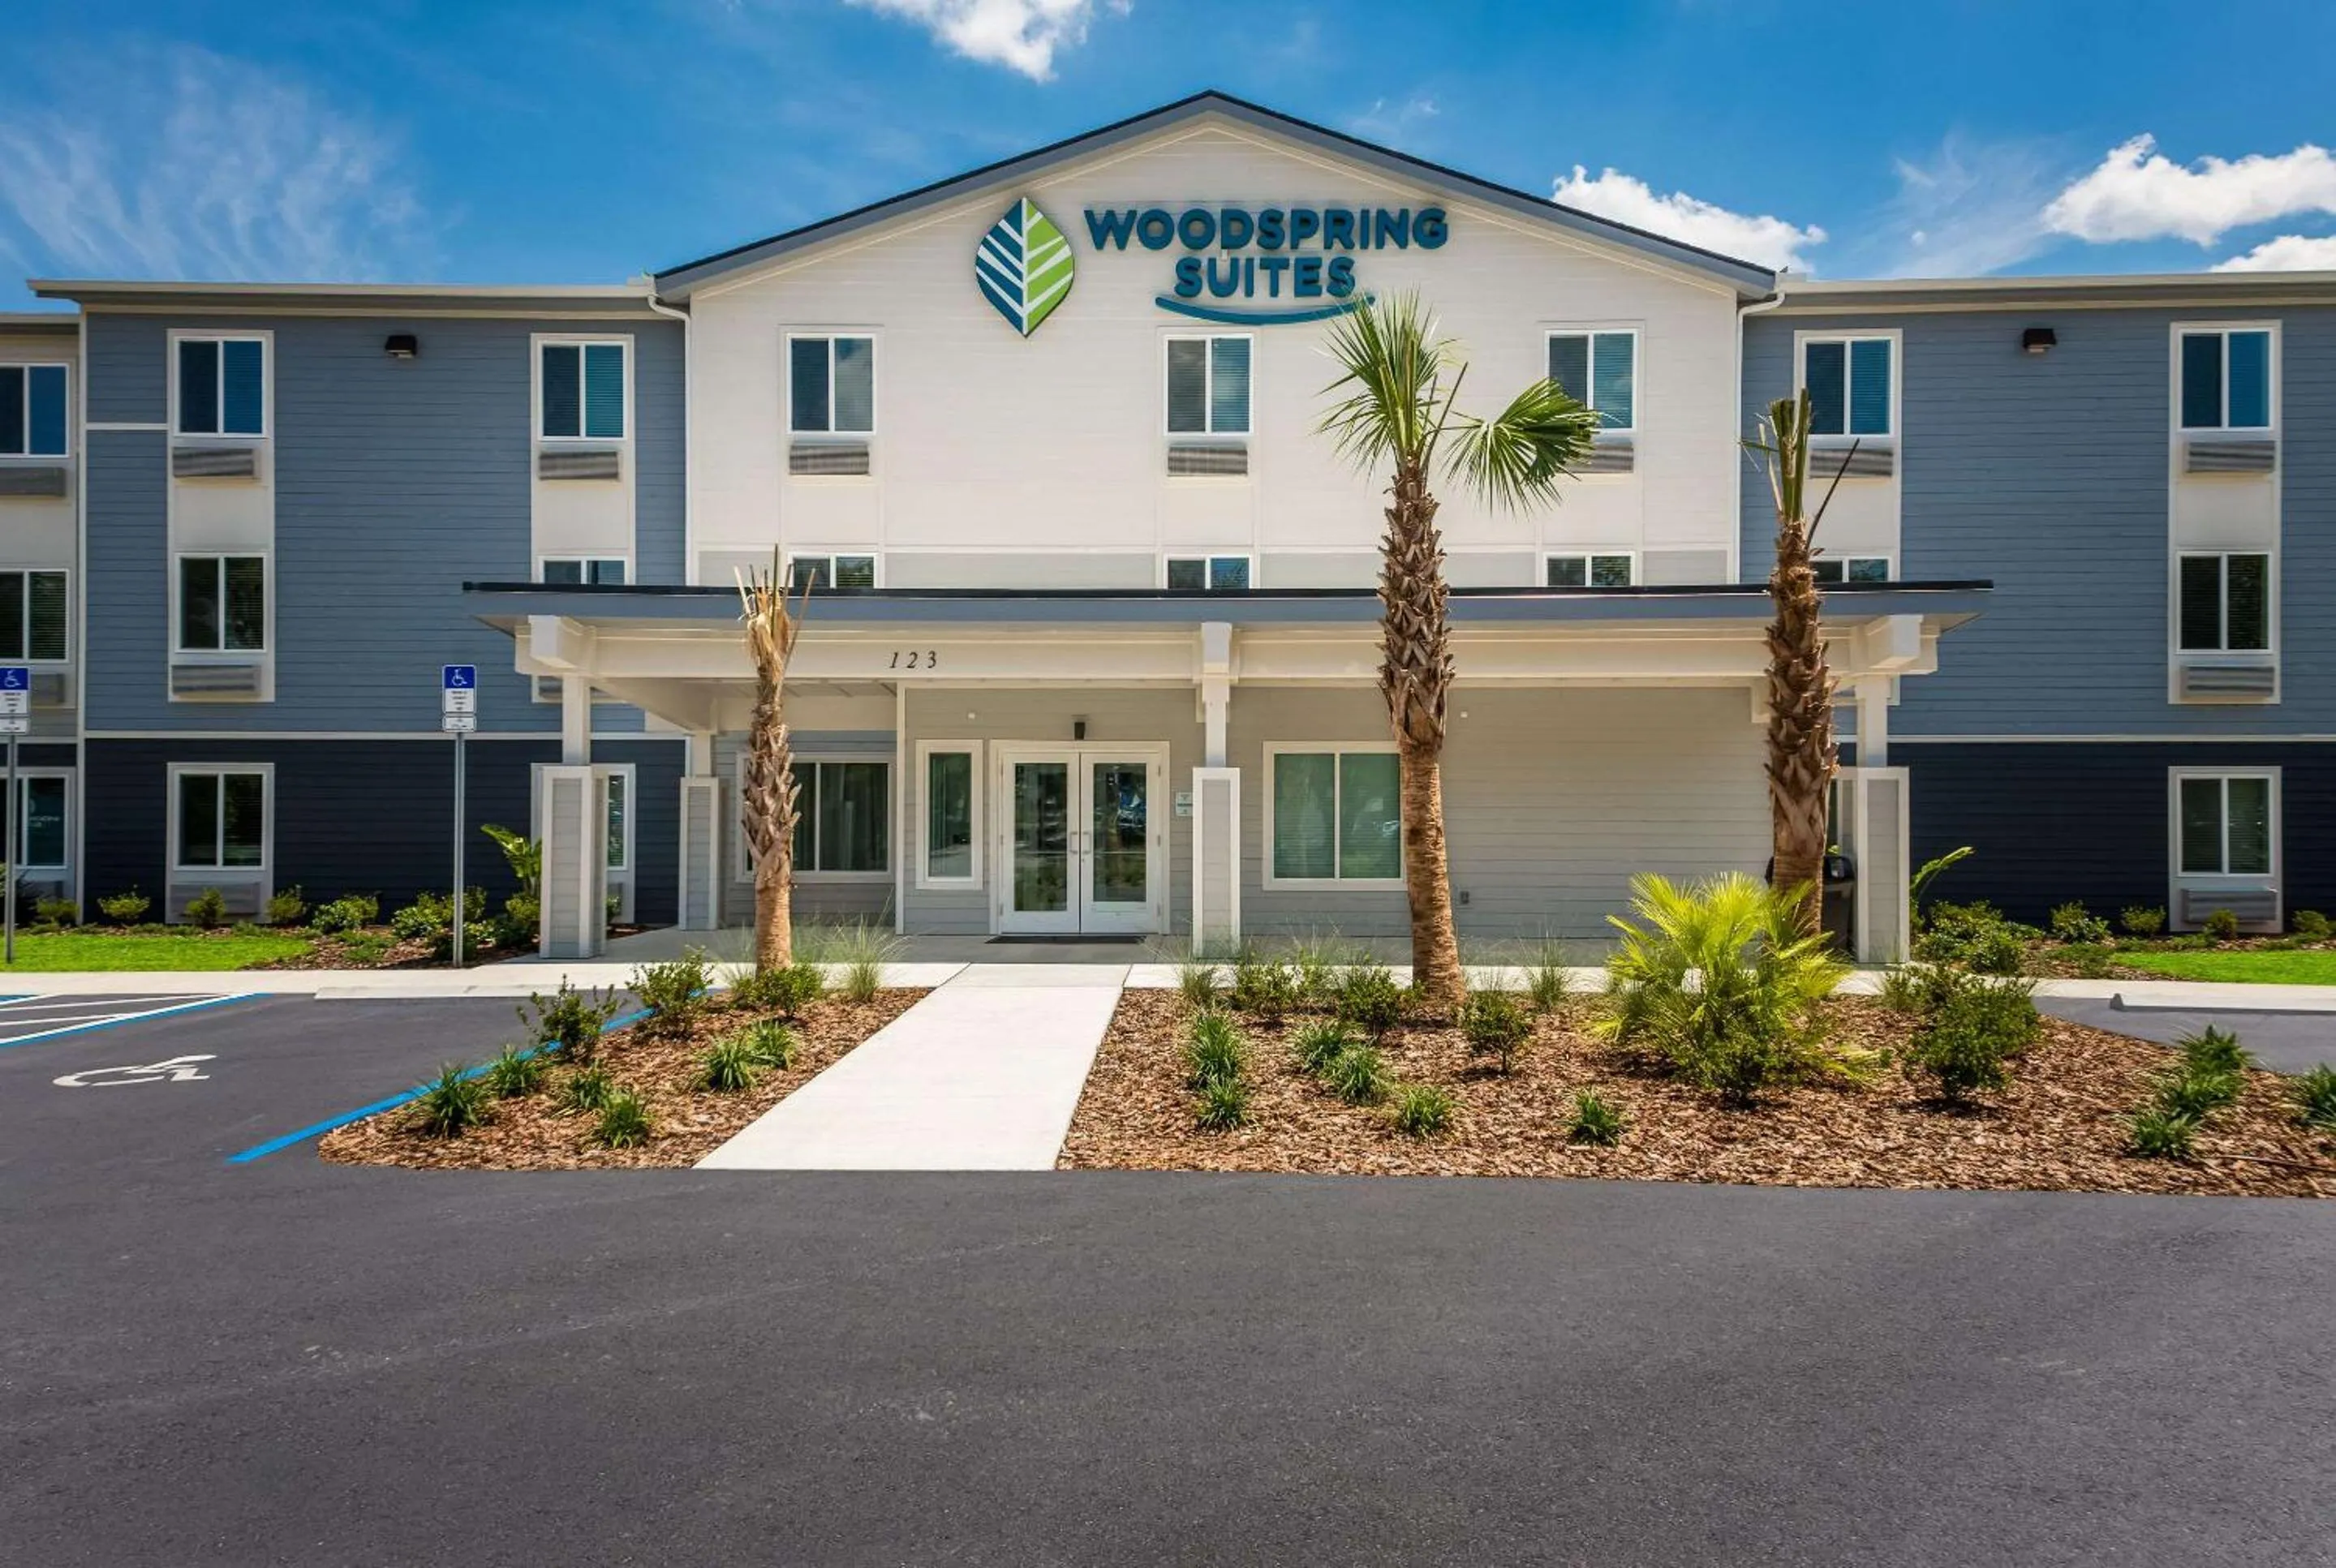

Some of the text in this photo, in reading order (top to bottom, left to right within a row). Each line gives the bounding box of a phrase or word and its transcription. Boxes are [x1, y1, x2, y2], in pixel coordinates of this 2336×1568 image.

[1084, 208, 1448, 251] WOODSPRING
[1173, 256, 1355, 298] SUITES
[889, 651, 936, 668] 123
